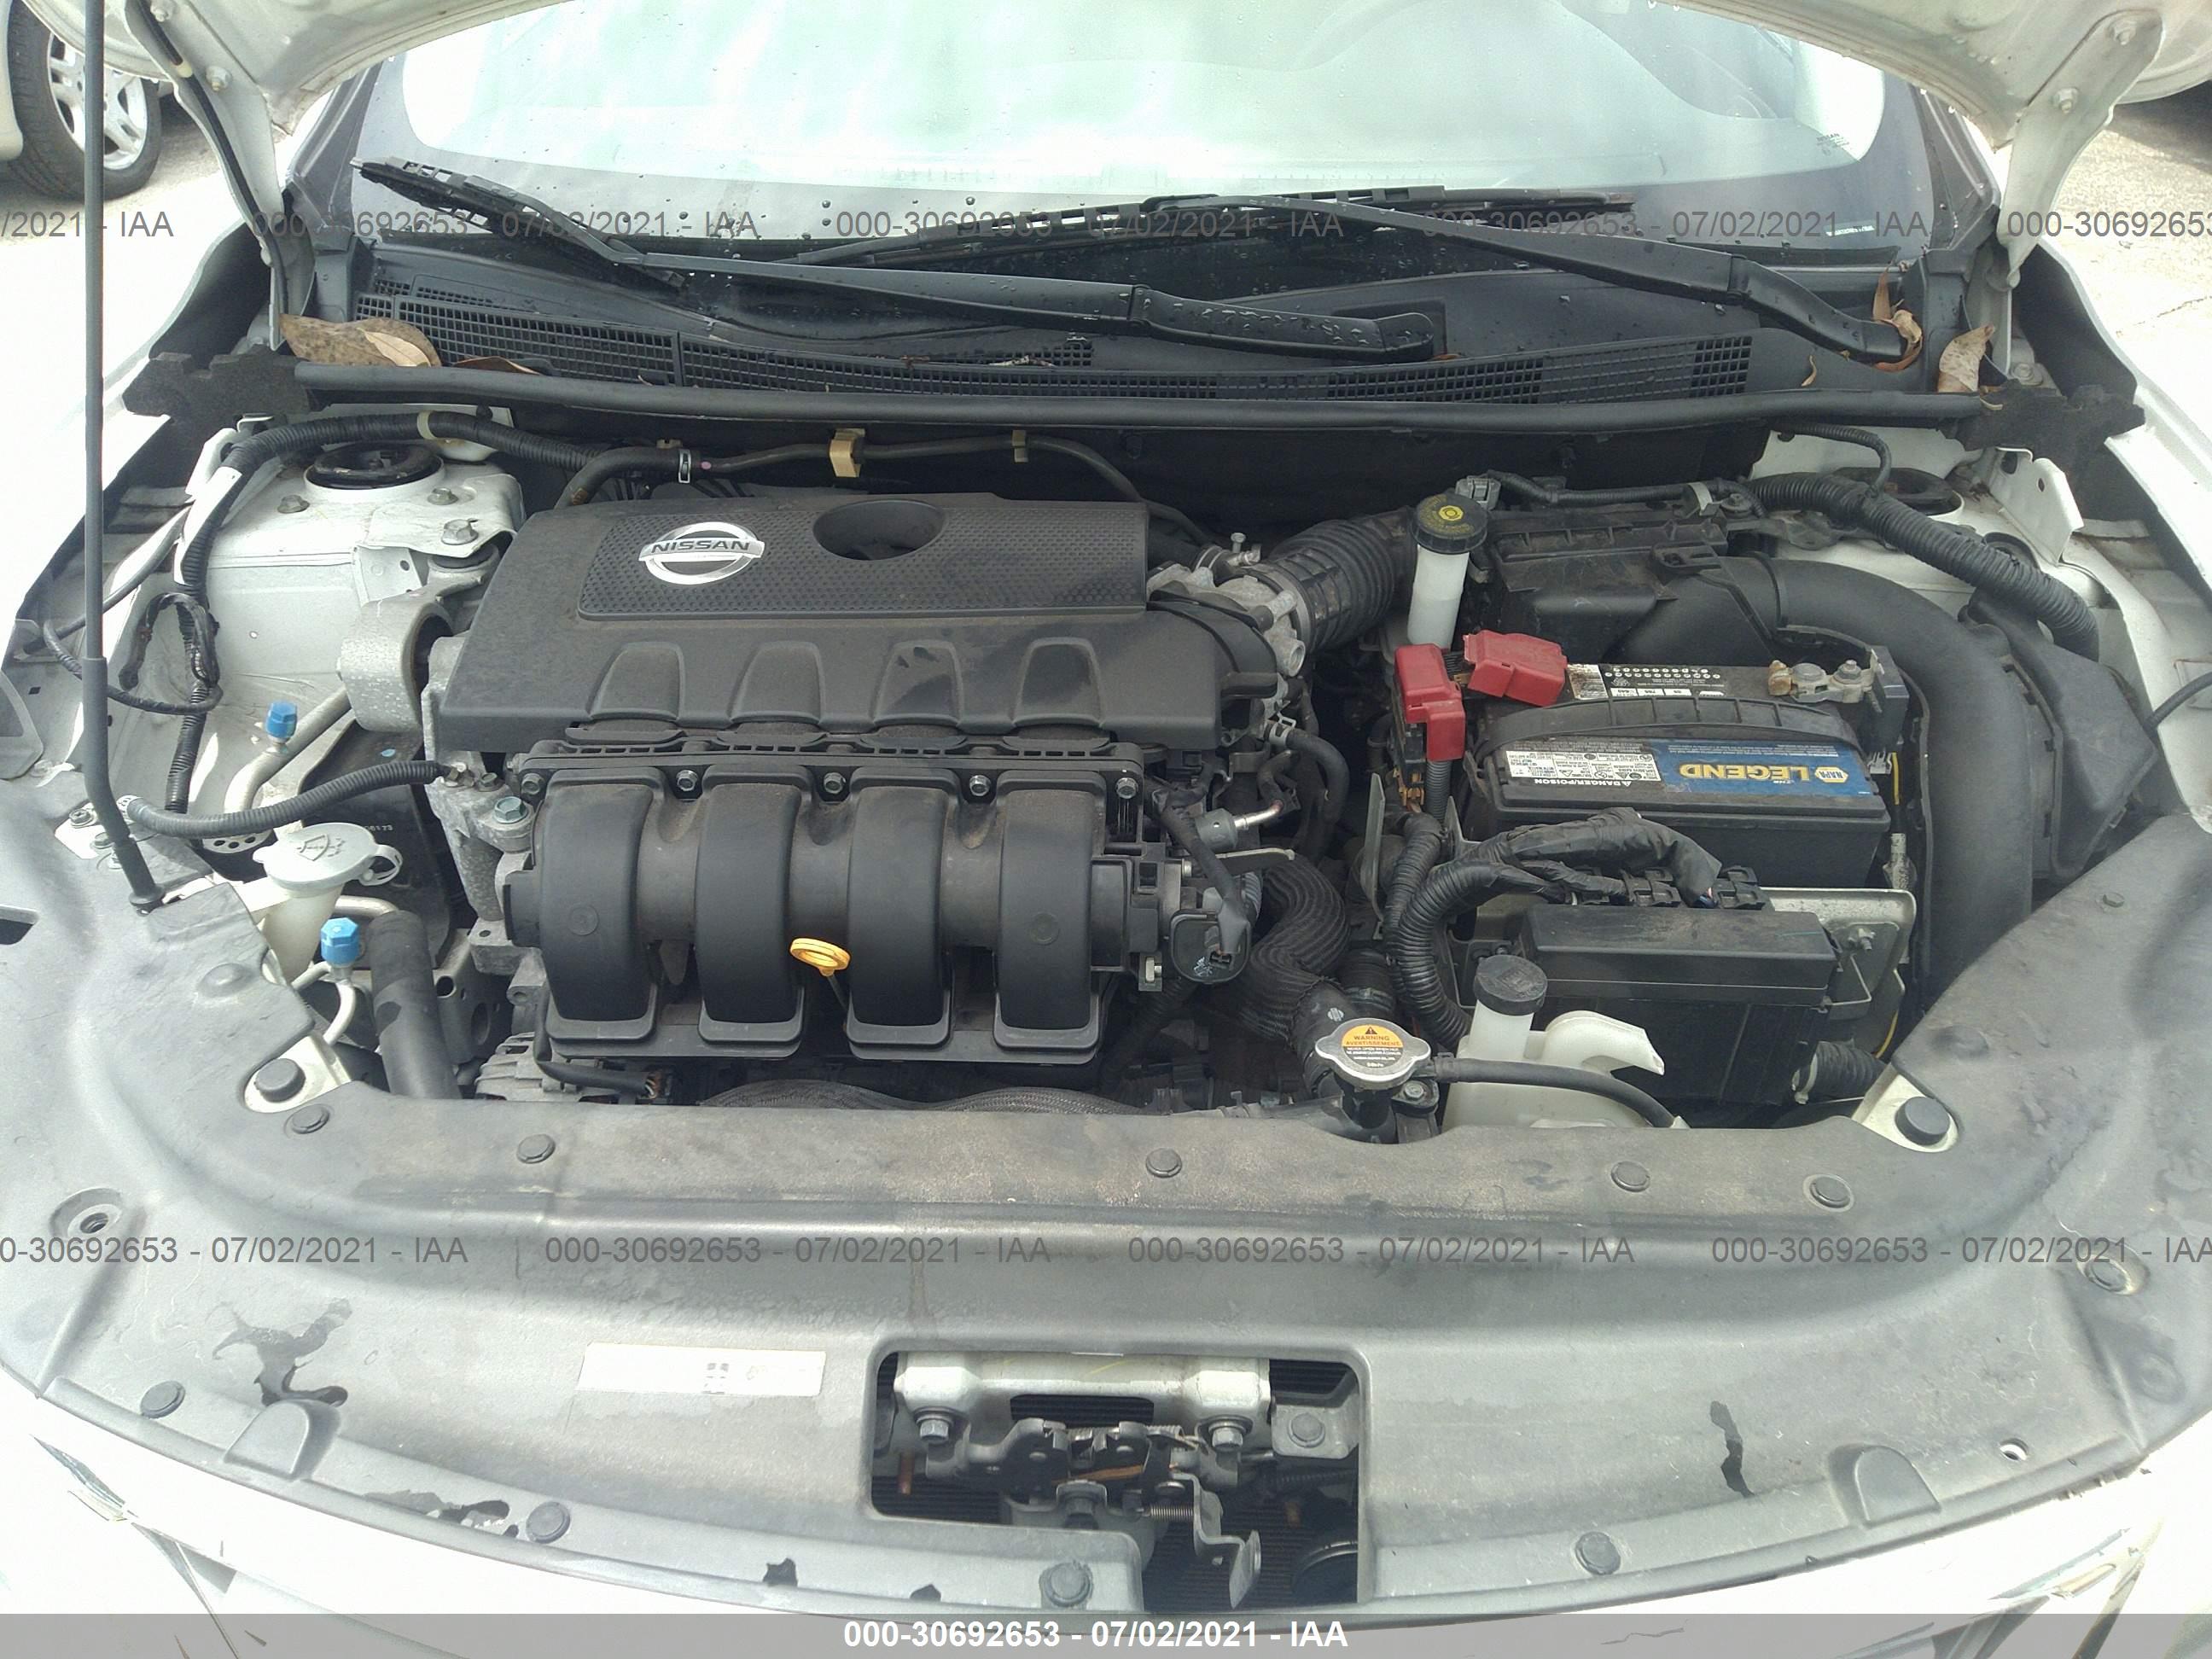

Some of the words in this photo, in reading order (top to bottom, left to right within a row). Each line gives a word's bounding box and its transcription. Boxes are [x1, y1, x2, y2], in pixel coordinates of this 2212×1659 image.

[651, 540, 751, 554] NISSAN
[1679, 764, 1810, 781] LEGEND
[1819, 770, 1844, 781] NAPA
[1535, 778, 1620, 787] DANGER/POISON
